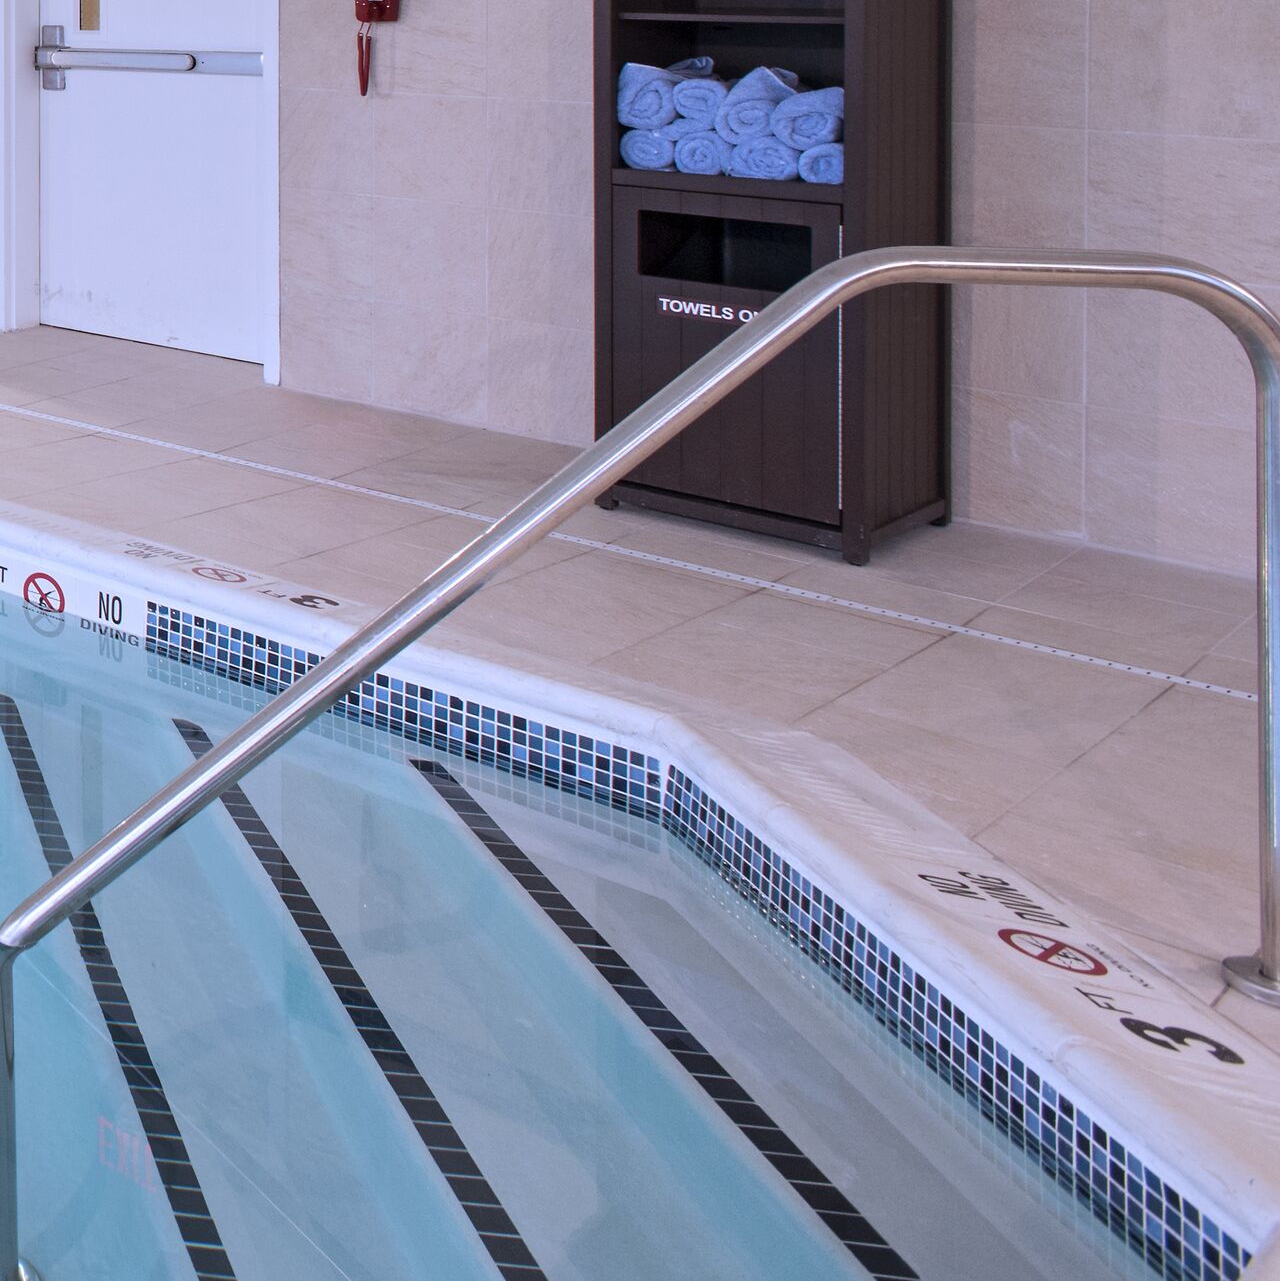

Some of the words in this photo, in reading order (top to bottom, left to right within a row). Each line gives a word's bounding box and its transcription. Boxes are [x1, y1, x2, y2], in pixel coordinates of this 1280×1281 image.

[658, 297, 735, 320] TOWELS
[738, 309, 760, 323] O
[98, 591, 123, 625] NO
[289, 594, 340, 610] 3
[80, 618, 140, 647] DIVING
[917, 873, 987, 902] NO
[958, 870, 1070, 929] DIVING
[1073, 985, 1135, 1015] FT
[1119, 1016, 1246, 1065] 3
